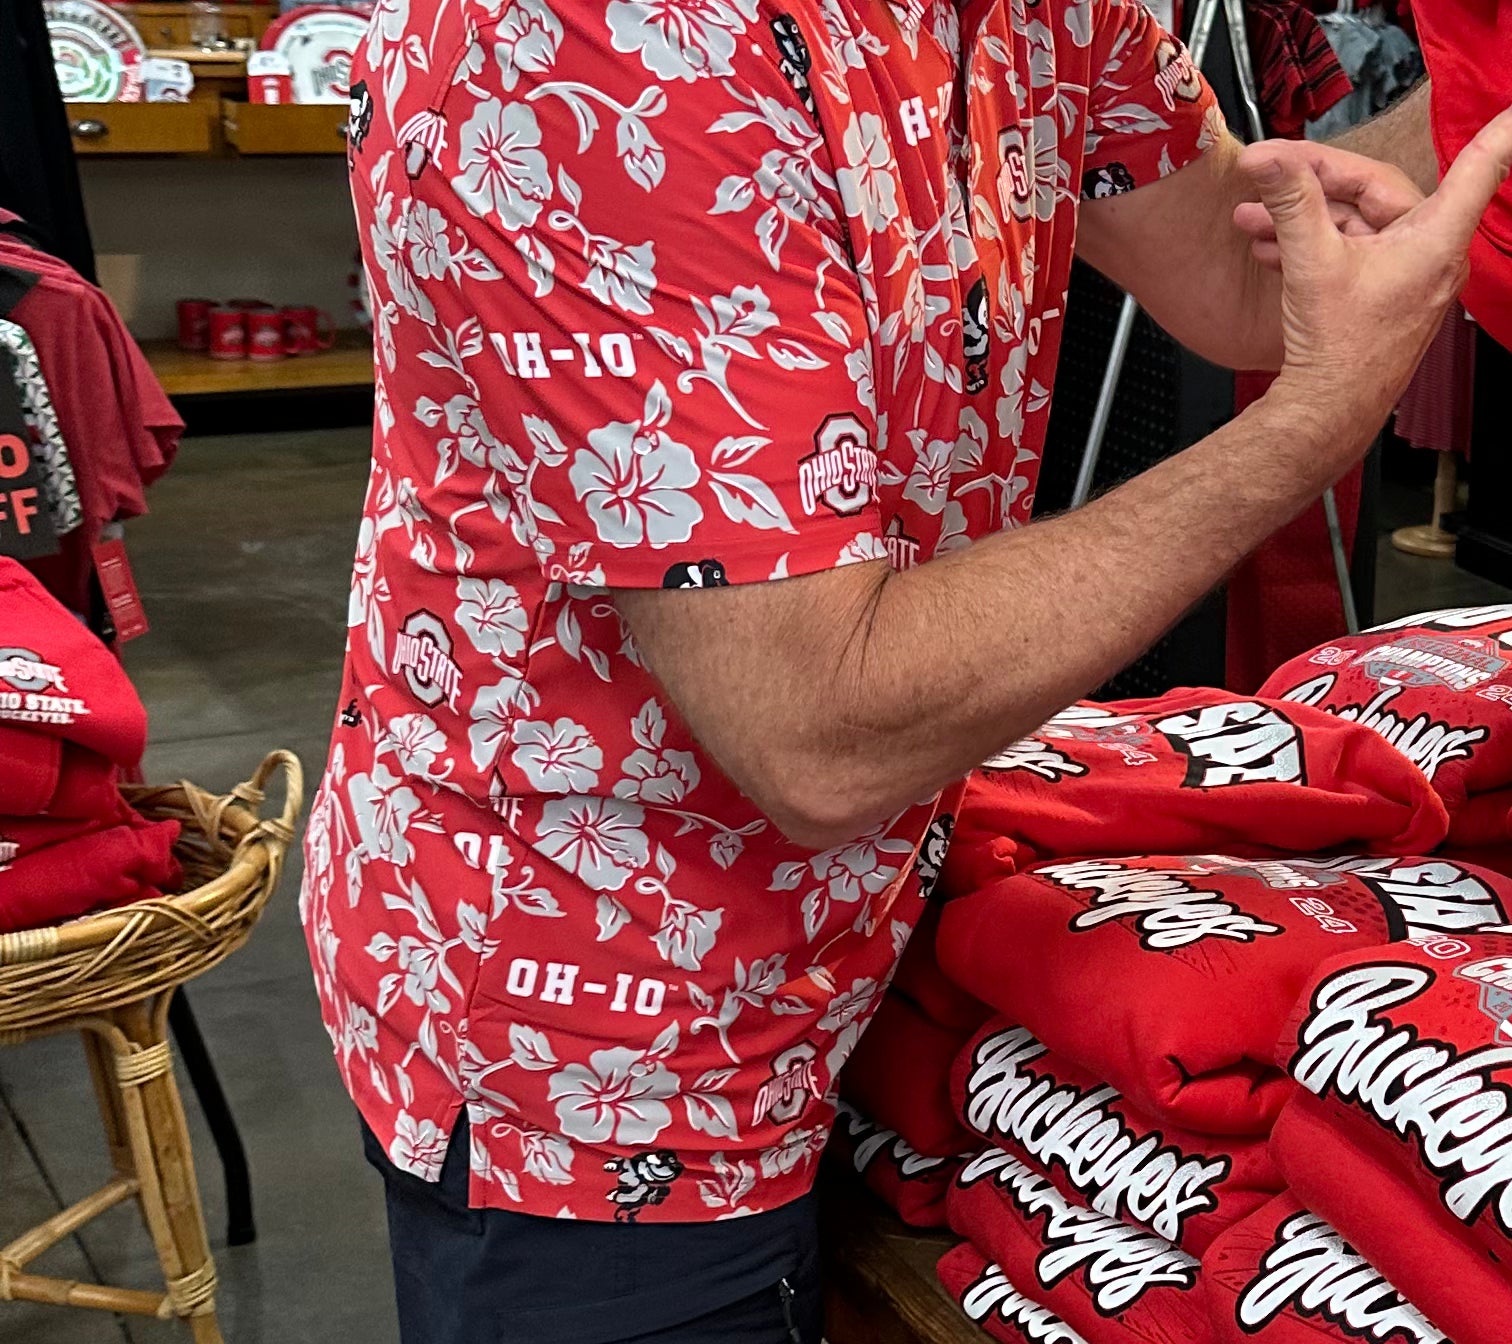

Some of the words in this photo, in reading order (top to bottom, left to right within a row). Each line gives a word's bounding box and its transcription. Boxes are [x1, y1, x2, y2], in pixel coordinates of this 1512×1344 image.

[25, 692, 85, 715] STATE
[1287, 894, 1360, 936] 24
[504, 956, 665, 1017] OH-IO
